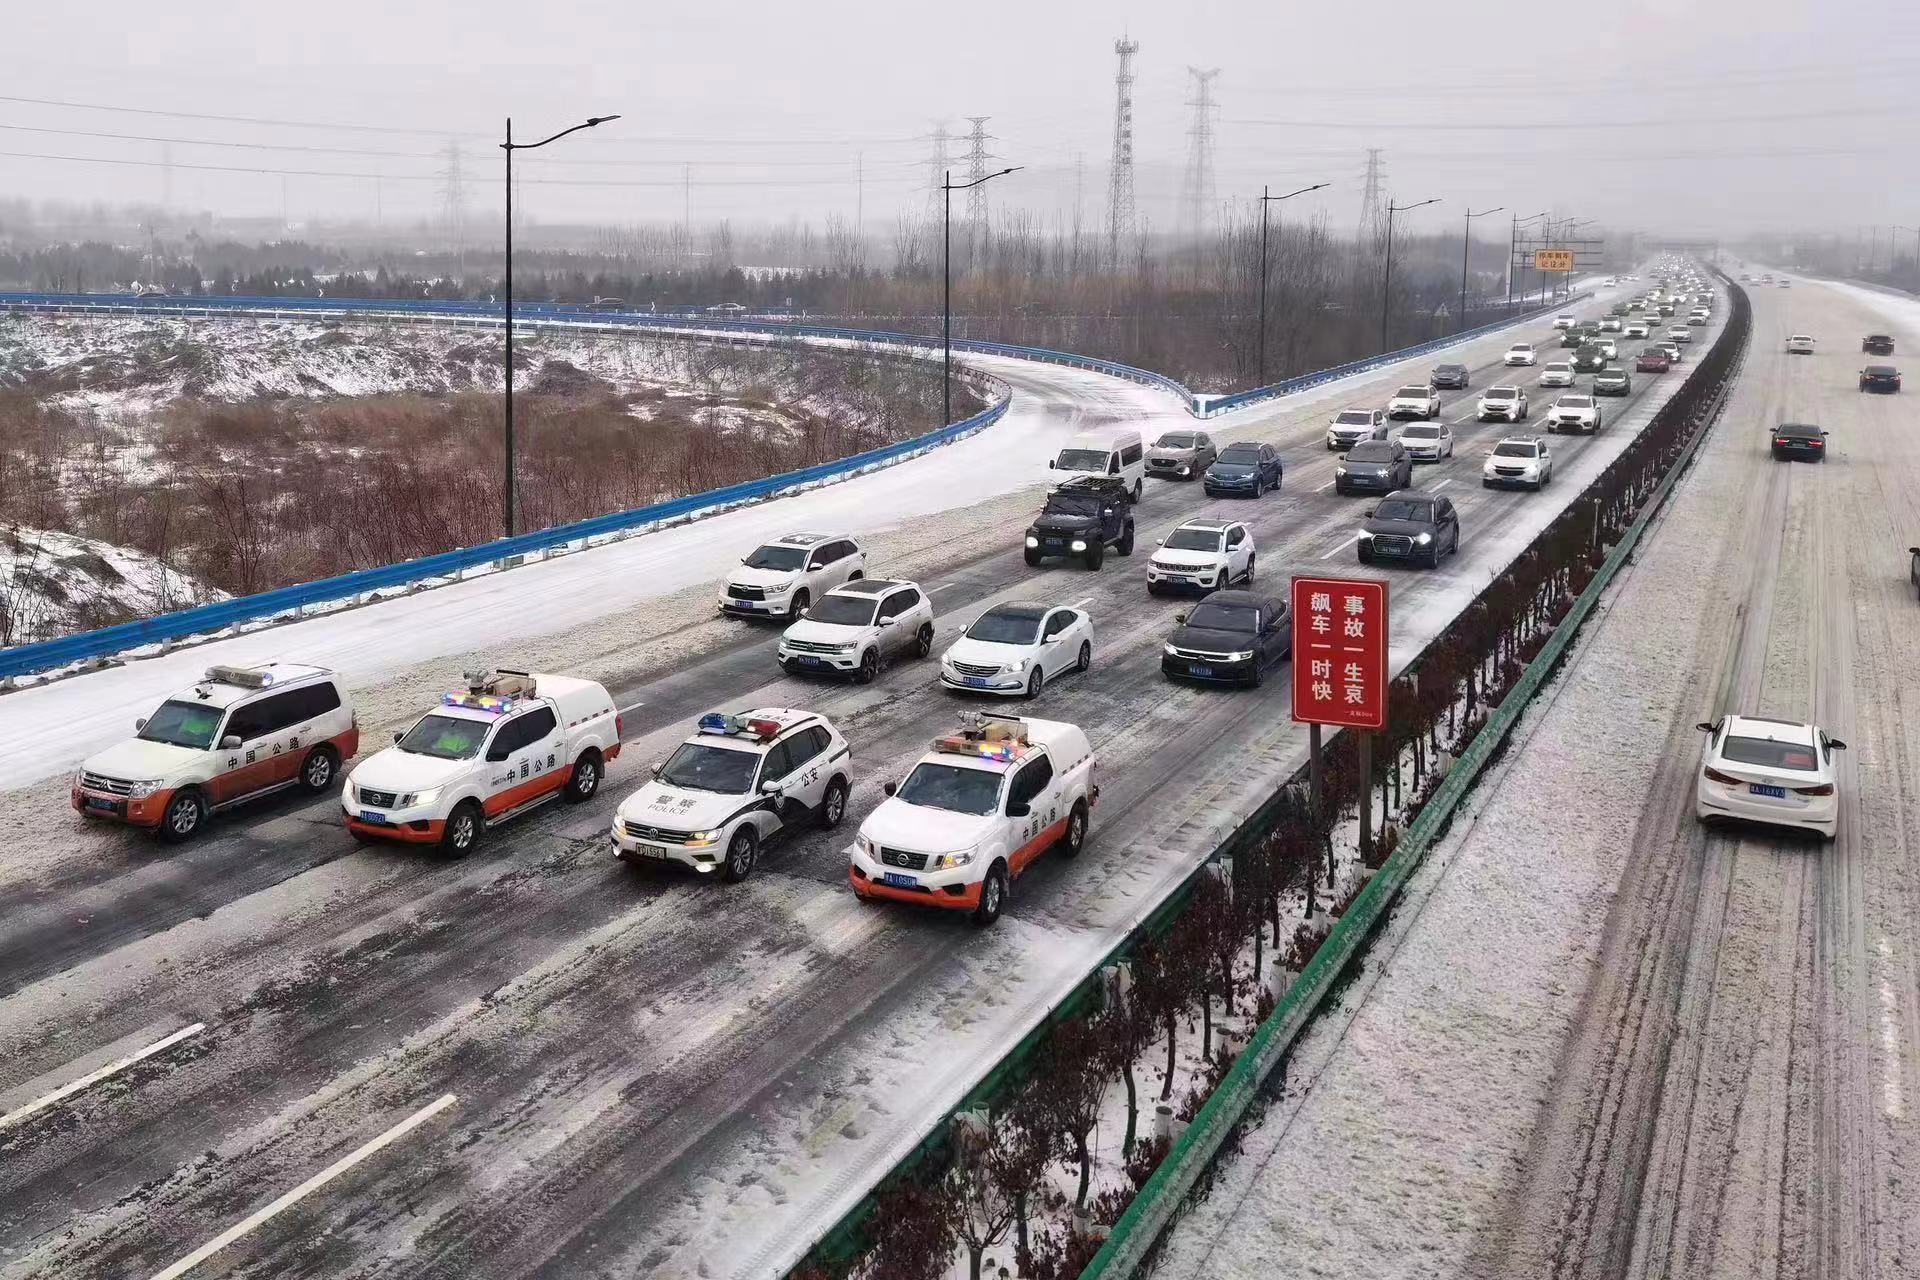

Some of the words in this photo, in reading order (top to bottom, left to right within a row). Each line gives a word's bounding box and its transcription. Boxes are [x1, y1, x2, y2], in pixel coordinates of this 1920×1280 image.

[1311, 592, 1333, 701] 飙车一时快
[1343, 595, 1366, 705] 事故一生哀
[228, 737, 299, 769] 中国公路
[507, 753, 555, 783] 中国公路
[801, 767, 819, 787] 公安
